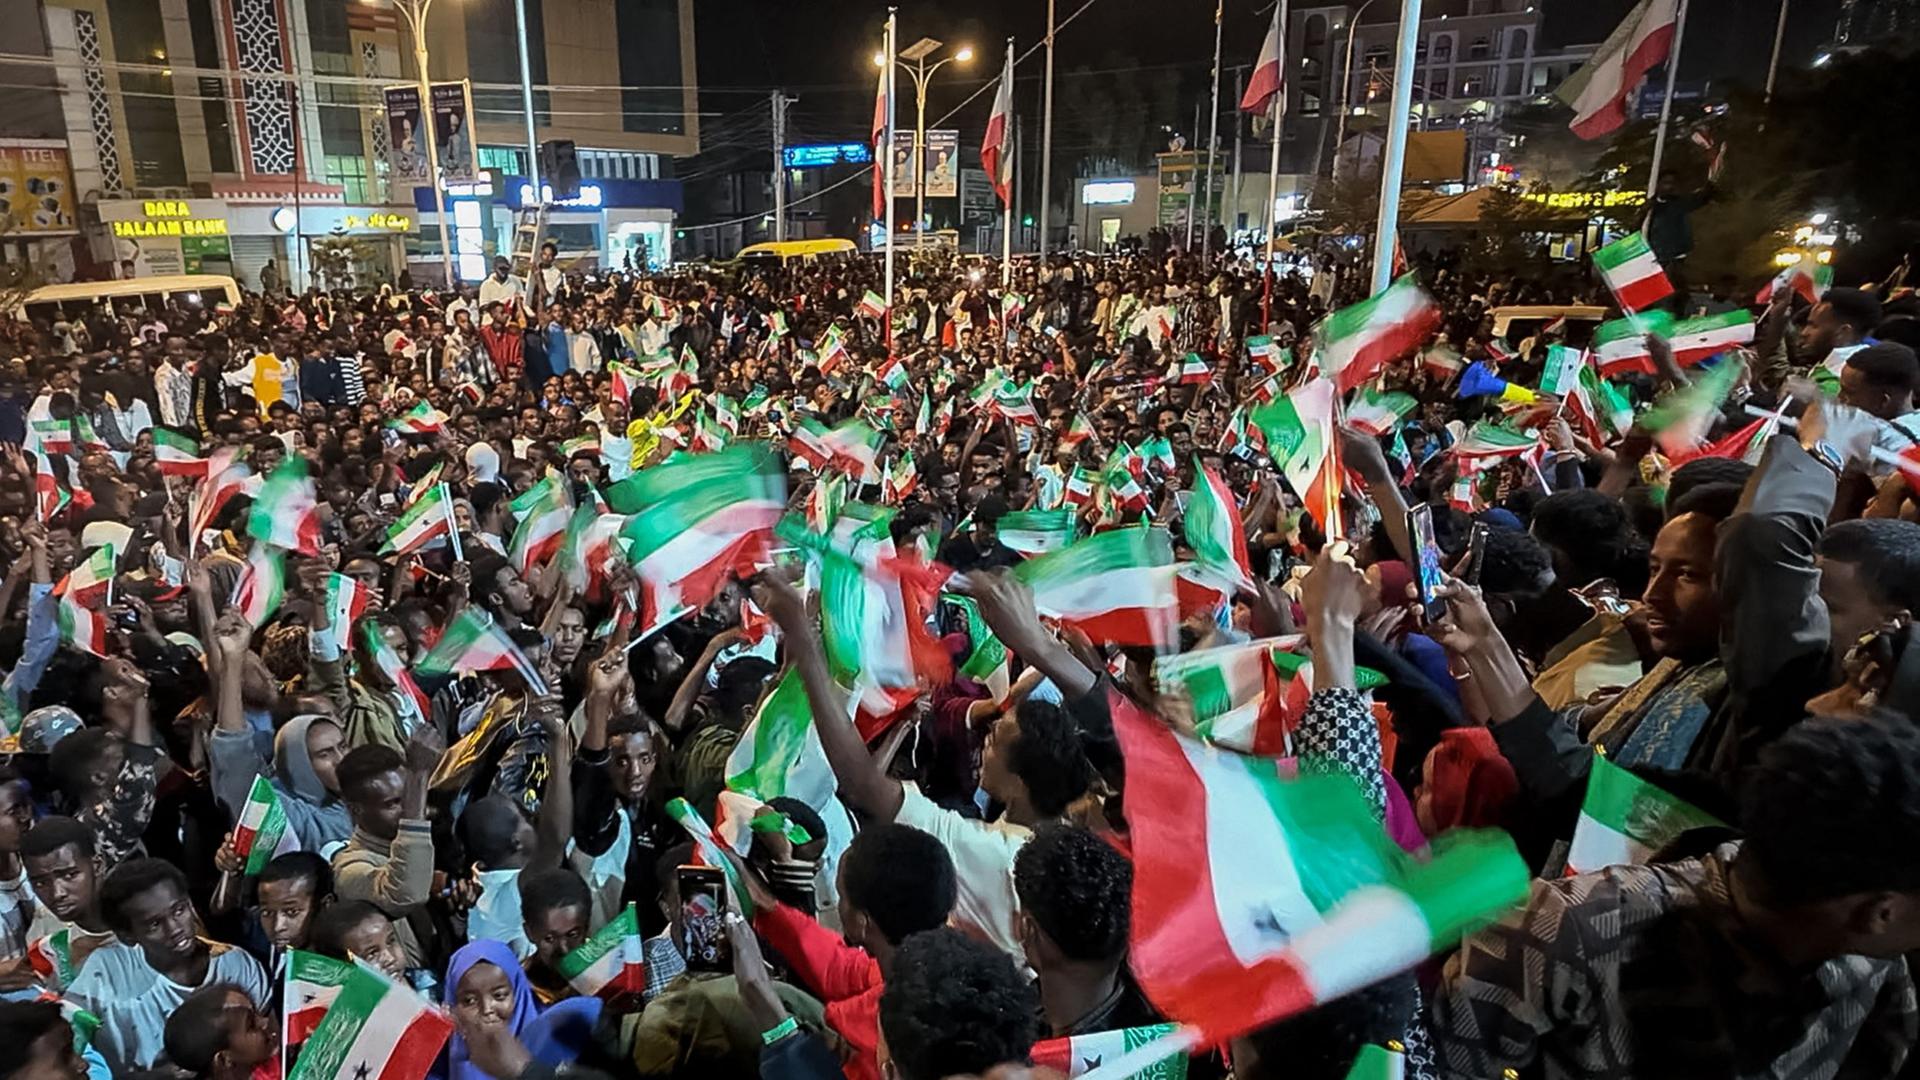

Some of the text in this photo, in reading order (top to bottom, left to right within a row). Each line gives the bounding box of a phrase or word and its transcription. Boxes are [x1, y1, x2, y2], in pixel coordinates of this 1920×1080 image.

[22, 149, 57, 162] ITEL
[144, 201, 190, 216] DARA
[182, 219, 226, 235] BANK
